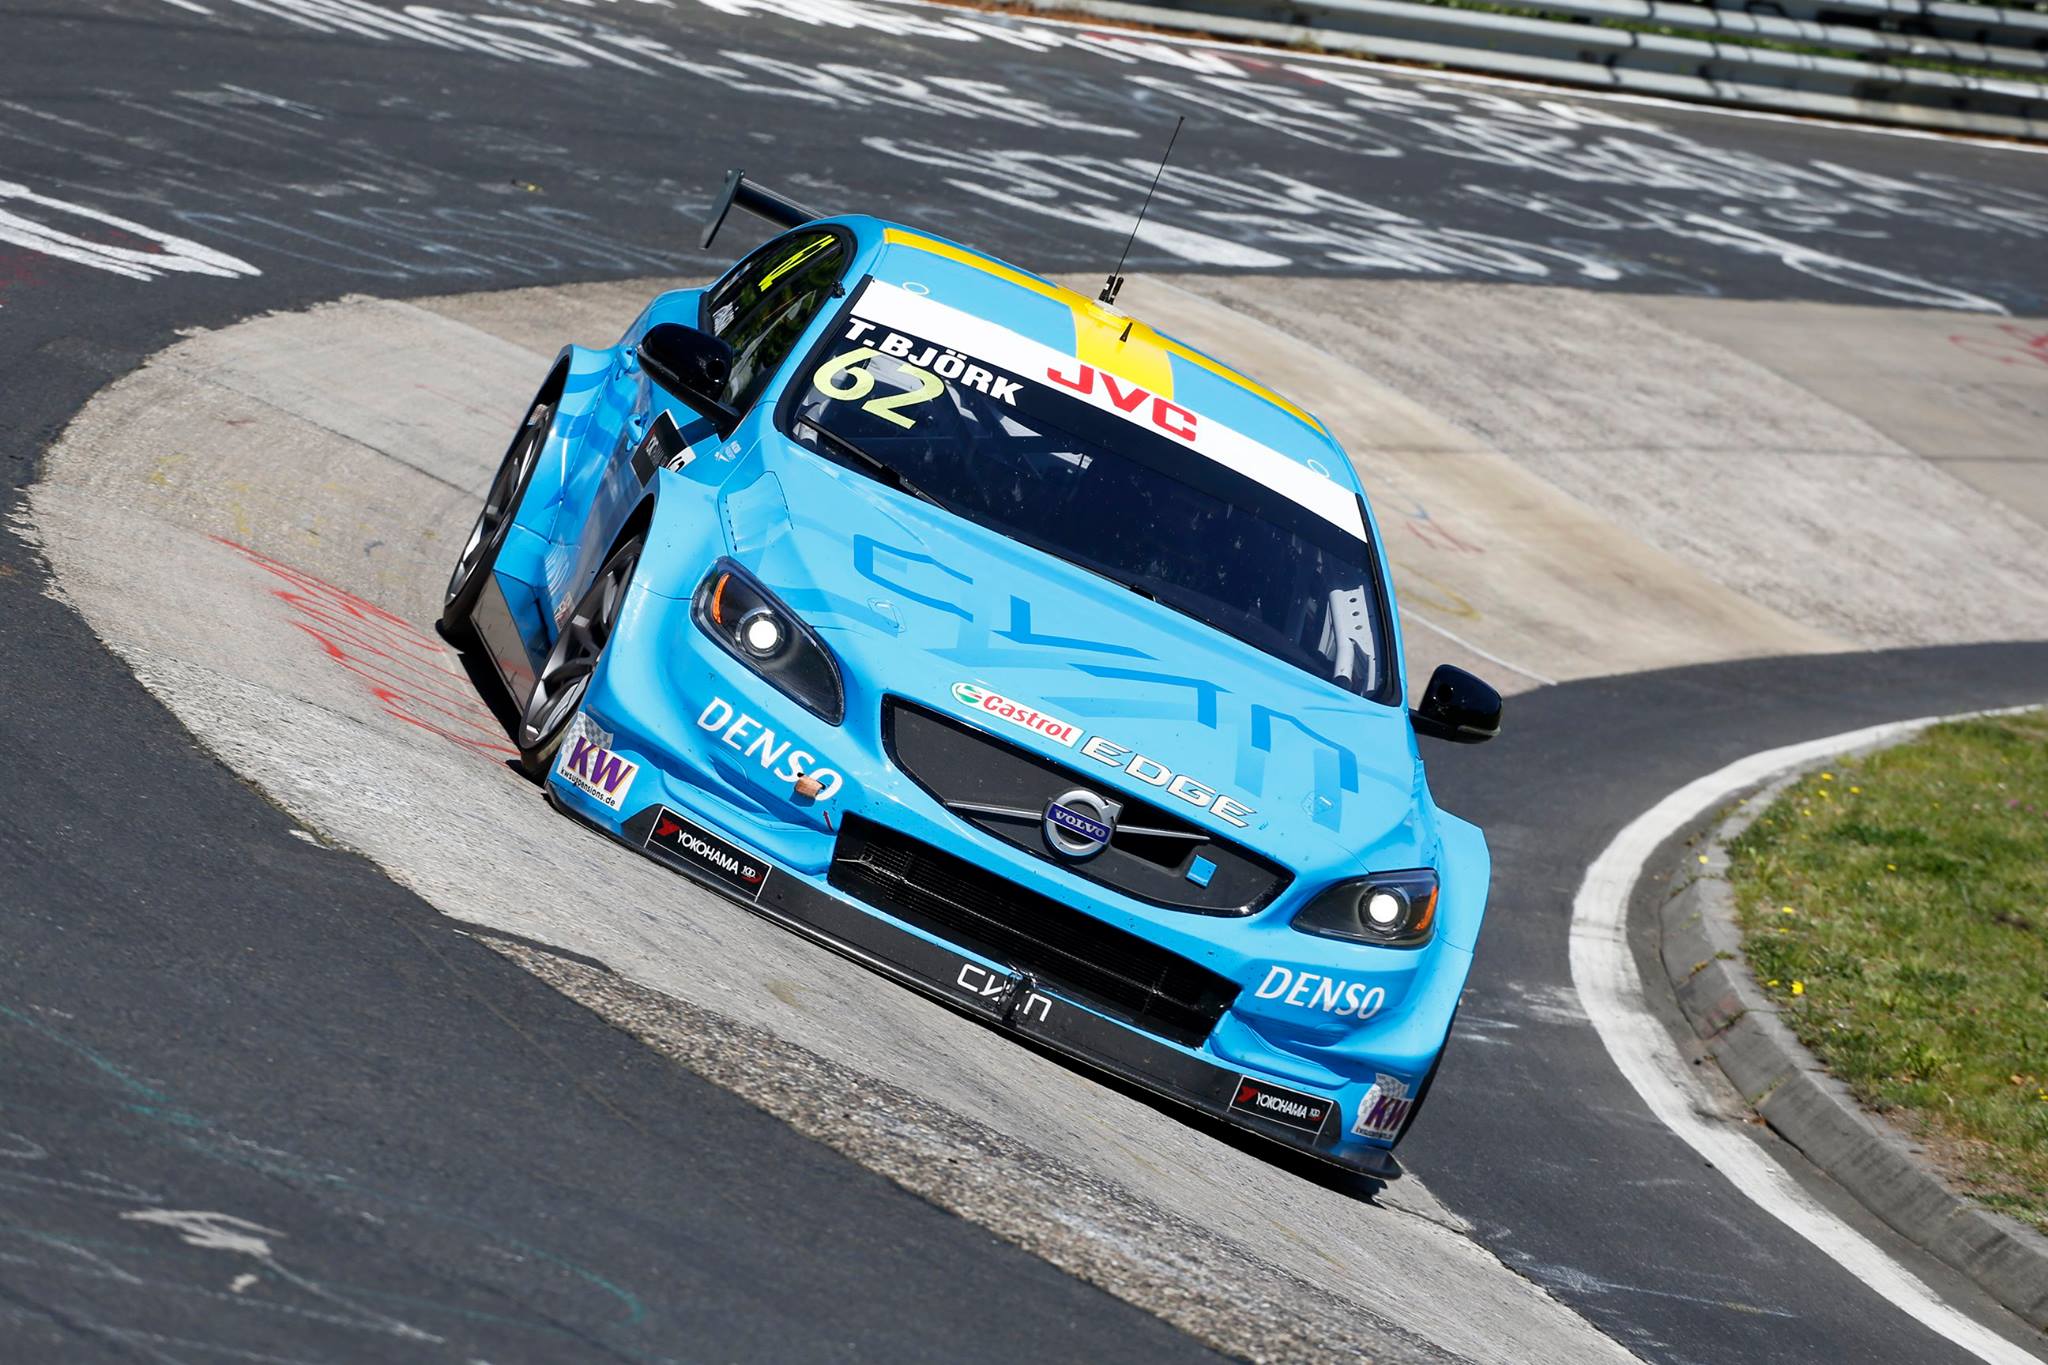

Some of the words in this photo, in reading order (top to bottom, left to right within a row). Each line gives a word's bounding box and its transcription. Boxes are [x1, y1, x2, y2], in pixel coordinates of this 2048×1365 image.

[813, 347, 945, 430] 62
[844, 317, 1024, 407] T.BJÖRK
[1047, 364, 1198, 442] JVC
[568, 736, 637, 795] KW
[696, 696, 844, 802] DENSO
[983, 694, 1073, 743] Castrol
[1080, 735, 1257, 829] EDGE
[560, 766, 617, 808] kwsuspensions.de
[676, 829, 740, 875] YOKOHAMA
[1054, 808, 1108, 839] VOLVO
[956, 963, 1052, 1022] CYN
[1254, 964, 1386, 1021] DENSO
[1256, 1091, 1309, 1120] YOKOHAMA
